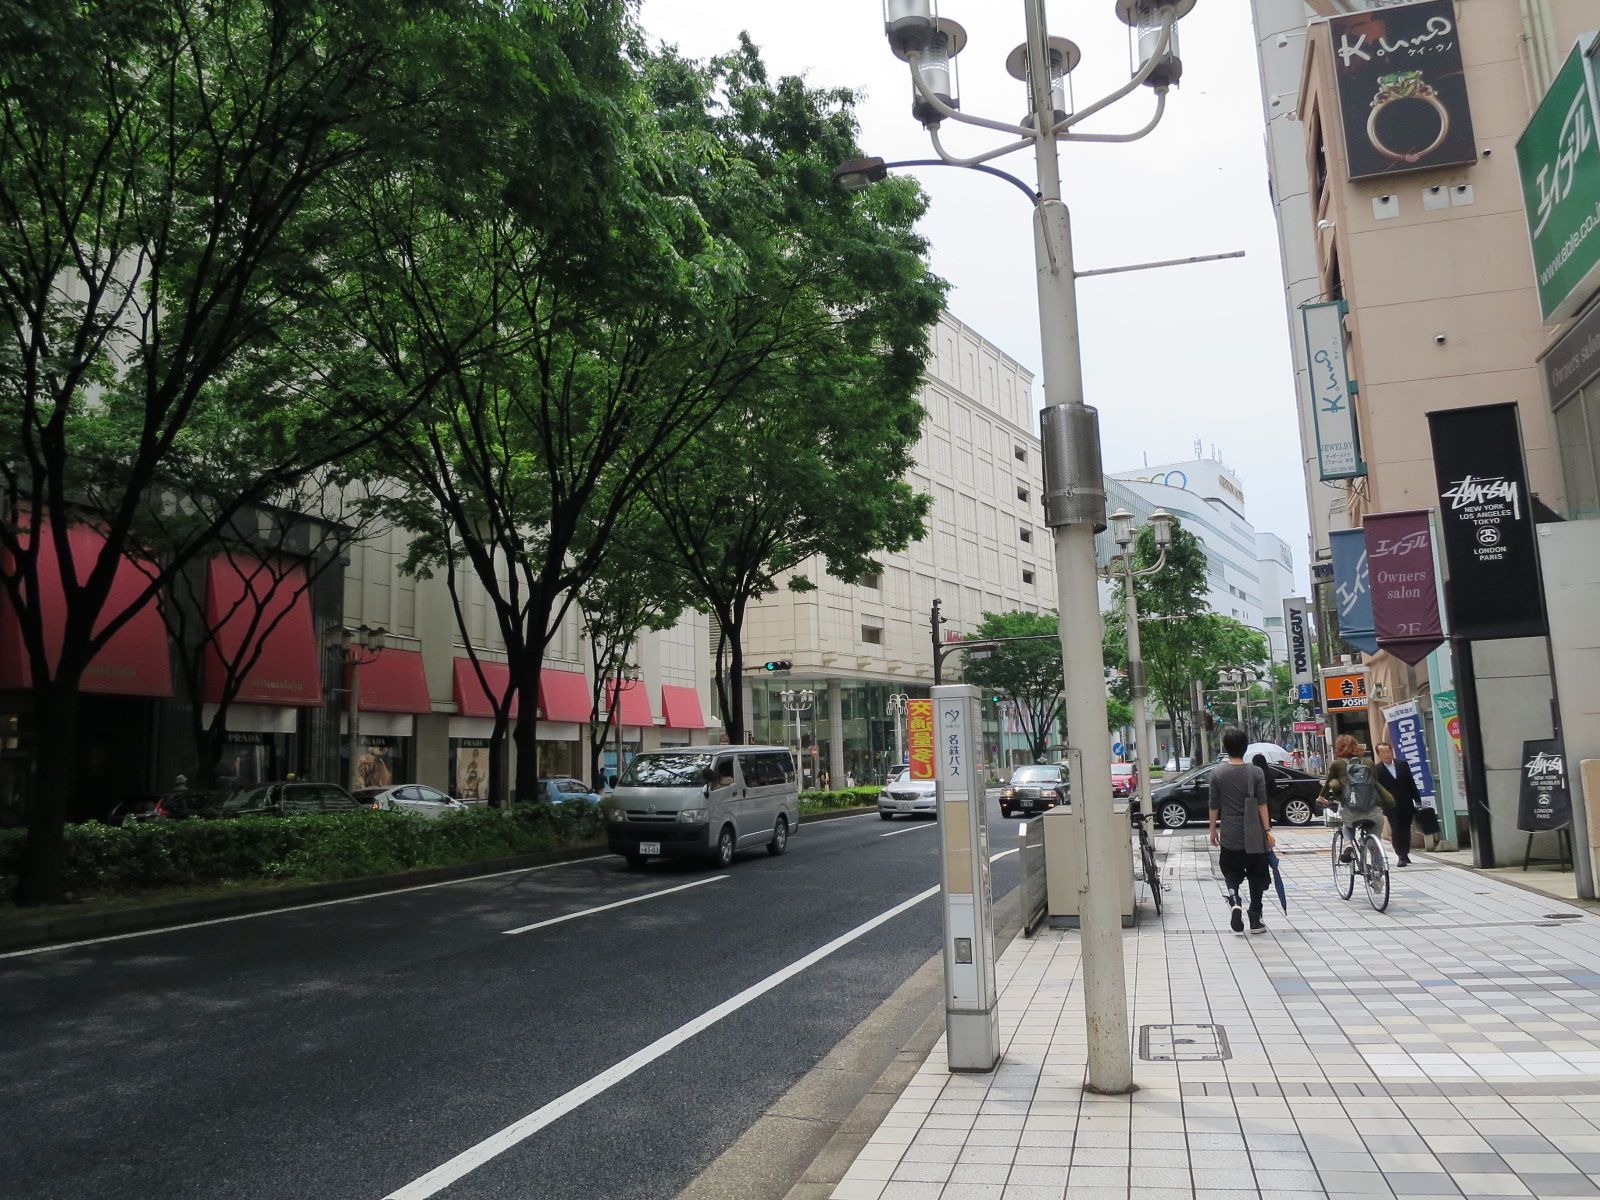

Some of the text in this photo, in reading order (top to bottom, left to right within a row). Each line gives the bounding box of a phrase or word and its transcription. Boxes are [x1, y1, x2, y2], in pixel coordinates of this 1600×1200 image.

[1533, 82, 1591, 241] エイブル
[1320, 442, 1353, 452] JEWELRY
[1464, 503, 1504, 513] NEW YORK
[1476, 509, 1512, 518] ANGELES
[1473, 517, 1500, 526] TOKYO
[1369, 530, 1429, 558] エイブル
[1473, 546, 1507, 555] LONDON
[1479, 553, 1503, 561] PARIS
[1377, 570, 1427, 583] Owners
[1335, 549, 1371, 617] エイ
[1387, 586, 1421, 599] salon
[1397, 622, 1421, 636] 2F
[1289, 608, 1308, 675] TONI&GUY
[228, 734, 260, 743] PRADA
[360, 736, 385, 745] PRADA
[948, 734, 960, 777] 名鉄バス
